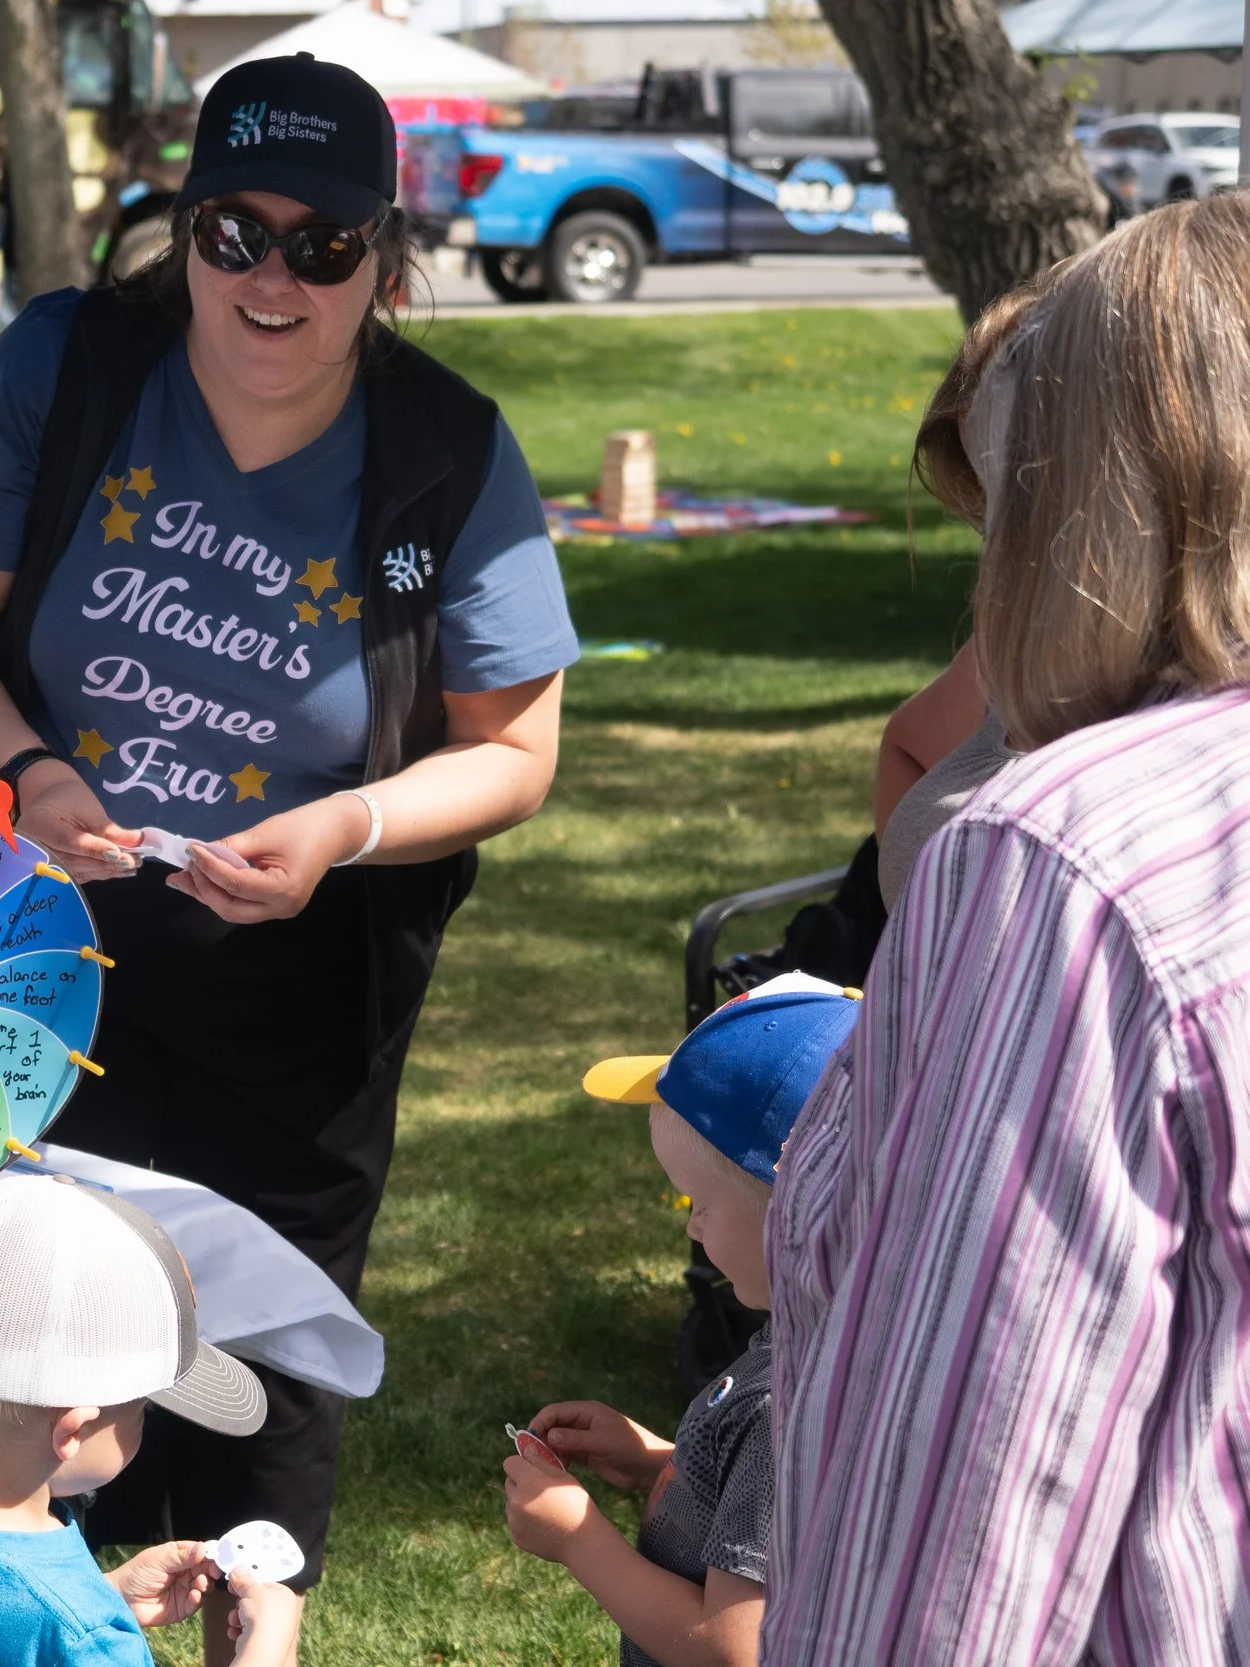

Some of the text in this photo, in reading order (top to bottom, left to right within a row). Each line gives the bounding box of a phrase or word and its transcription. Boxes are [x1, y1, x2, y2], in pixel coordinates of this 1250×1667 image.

[269, 110, 337, 132] Big Brothers
[268, 125, 327, 143] Big Sisters
[151, 501, 292, 597] In my
[81, 567, 312, 680] Master's
[81, 655, 278, 745] Degree
[102, 737, 226, 805] Era
[8, 913, 19, 924] a
[25, 895, 58, 916] deep
[59, 972, 76, 983] on
[23, 984, 57, 1006] foot
[29, 1030, 41, 1047] 1
[21, 1050, 42, 1066] of
[3, 1070, 31, 1086] your
[15, 1084, 47, 1100] brain
